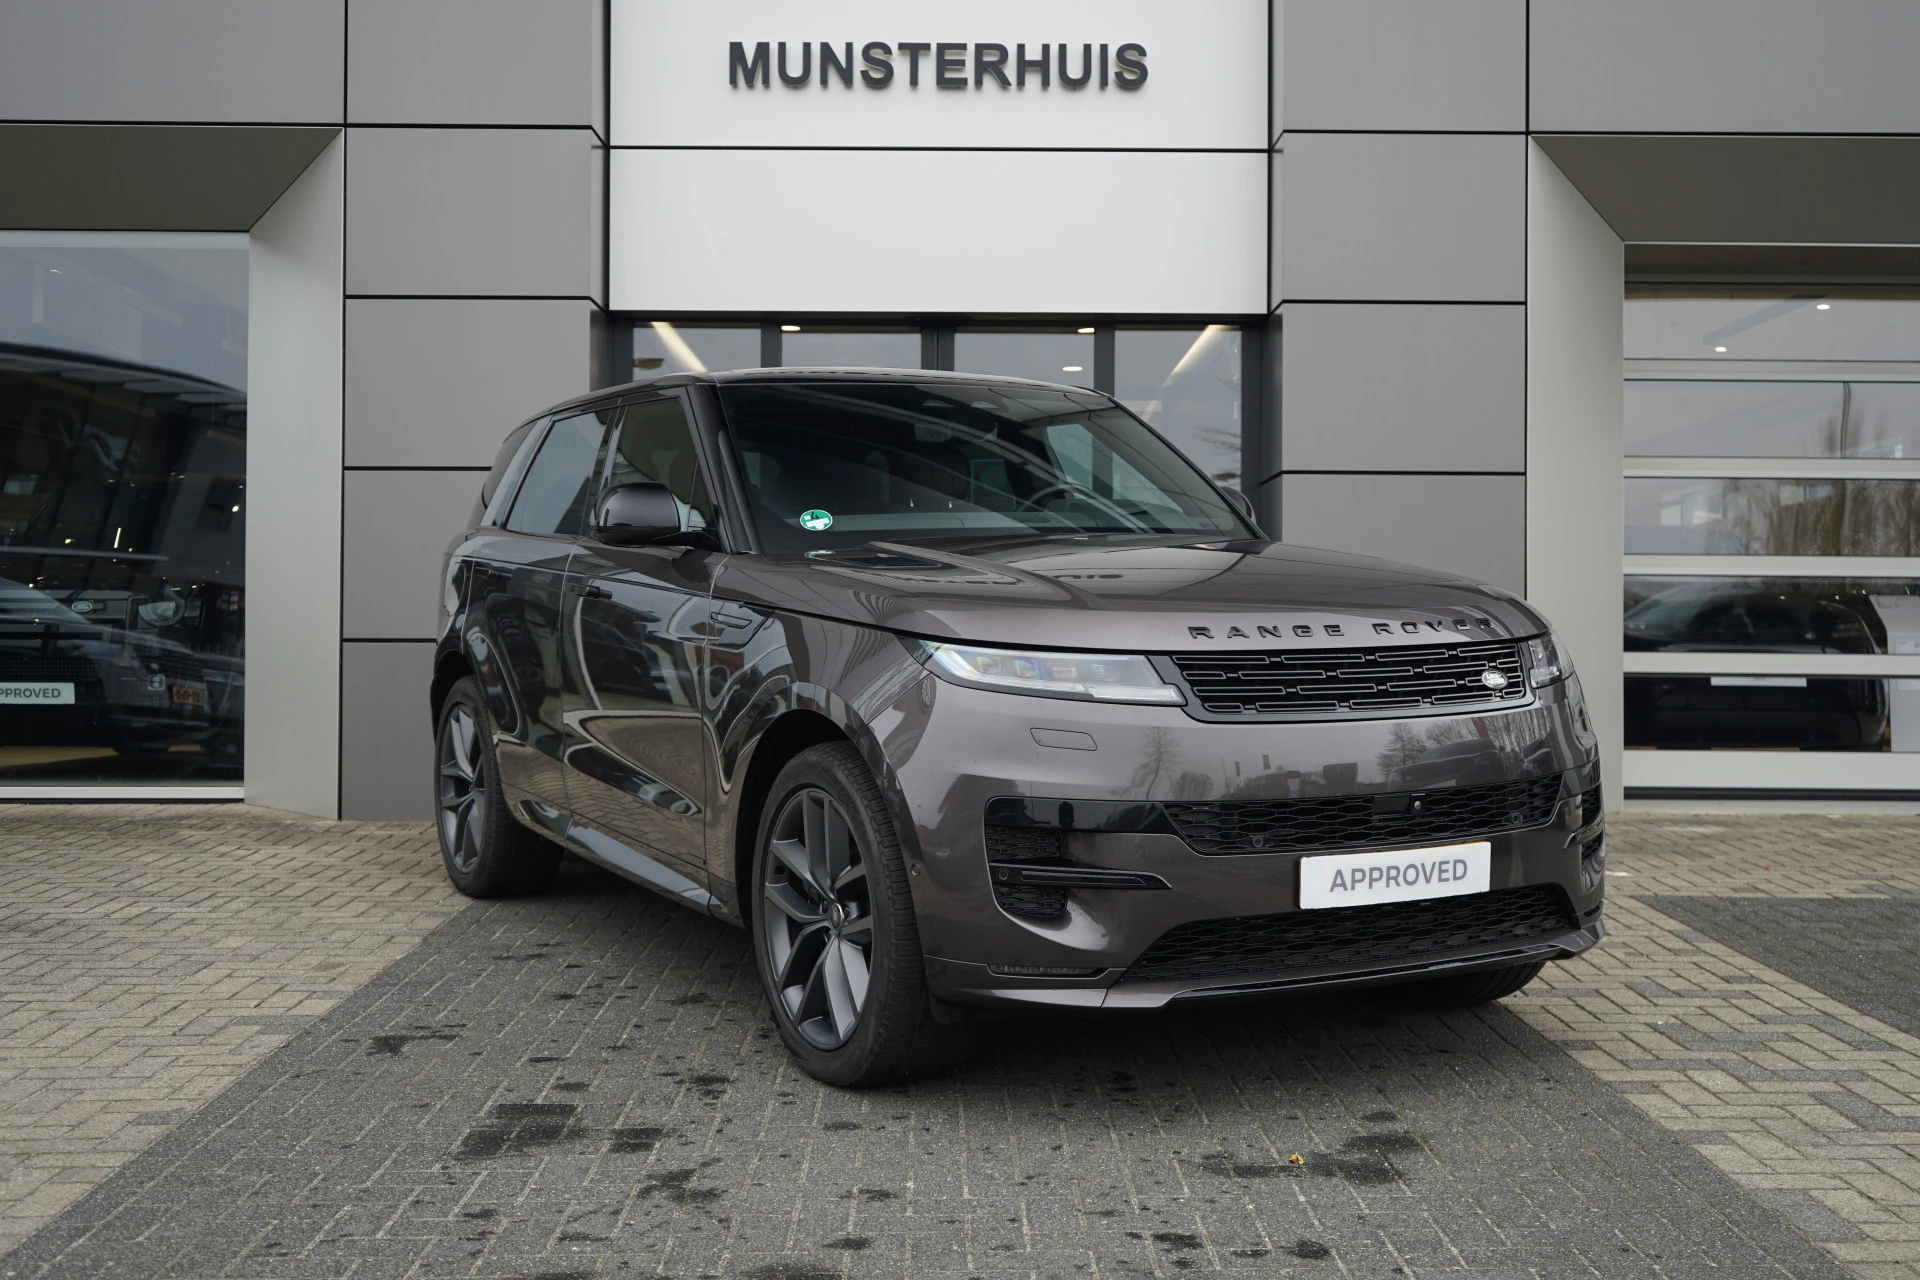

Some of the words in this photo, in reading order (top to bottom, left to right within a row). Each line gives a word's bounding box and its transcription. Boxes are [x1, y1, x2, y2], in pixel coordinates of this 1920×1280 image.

[729, 41, 1149, 89] MUNSTERHUIS
[1187, 623, 1345, 640] RANGE
[1371, 617, 1495, 635] ROVER
[1329, 858, 1468, 893] APPROVED
